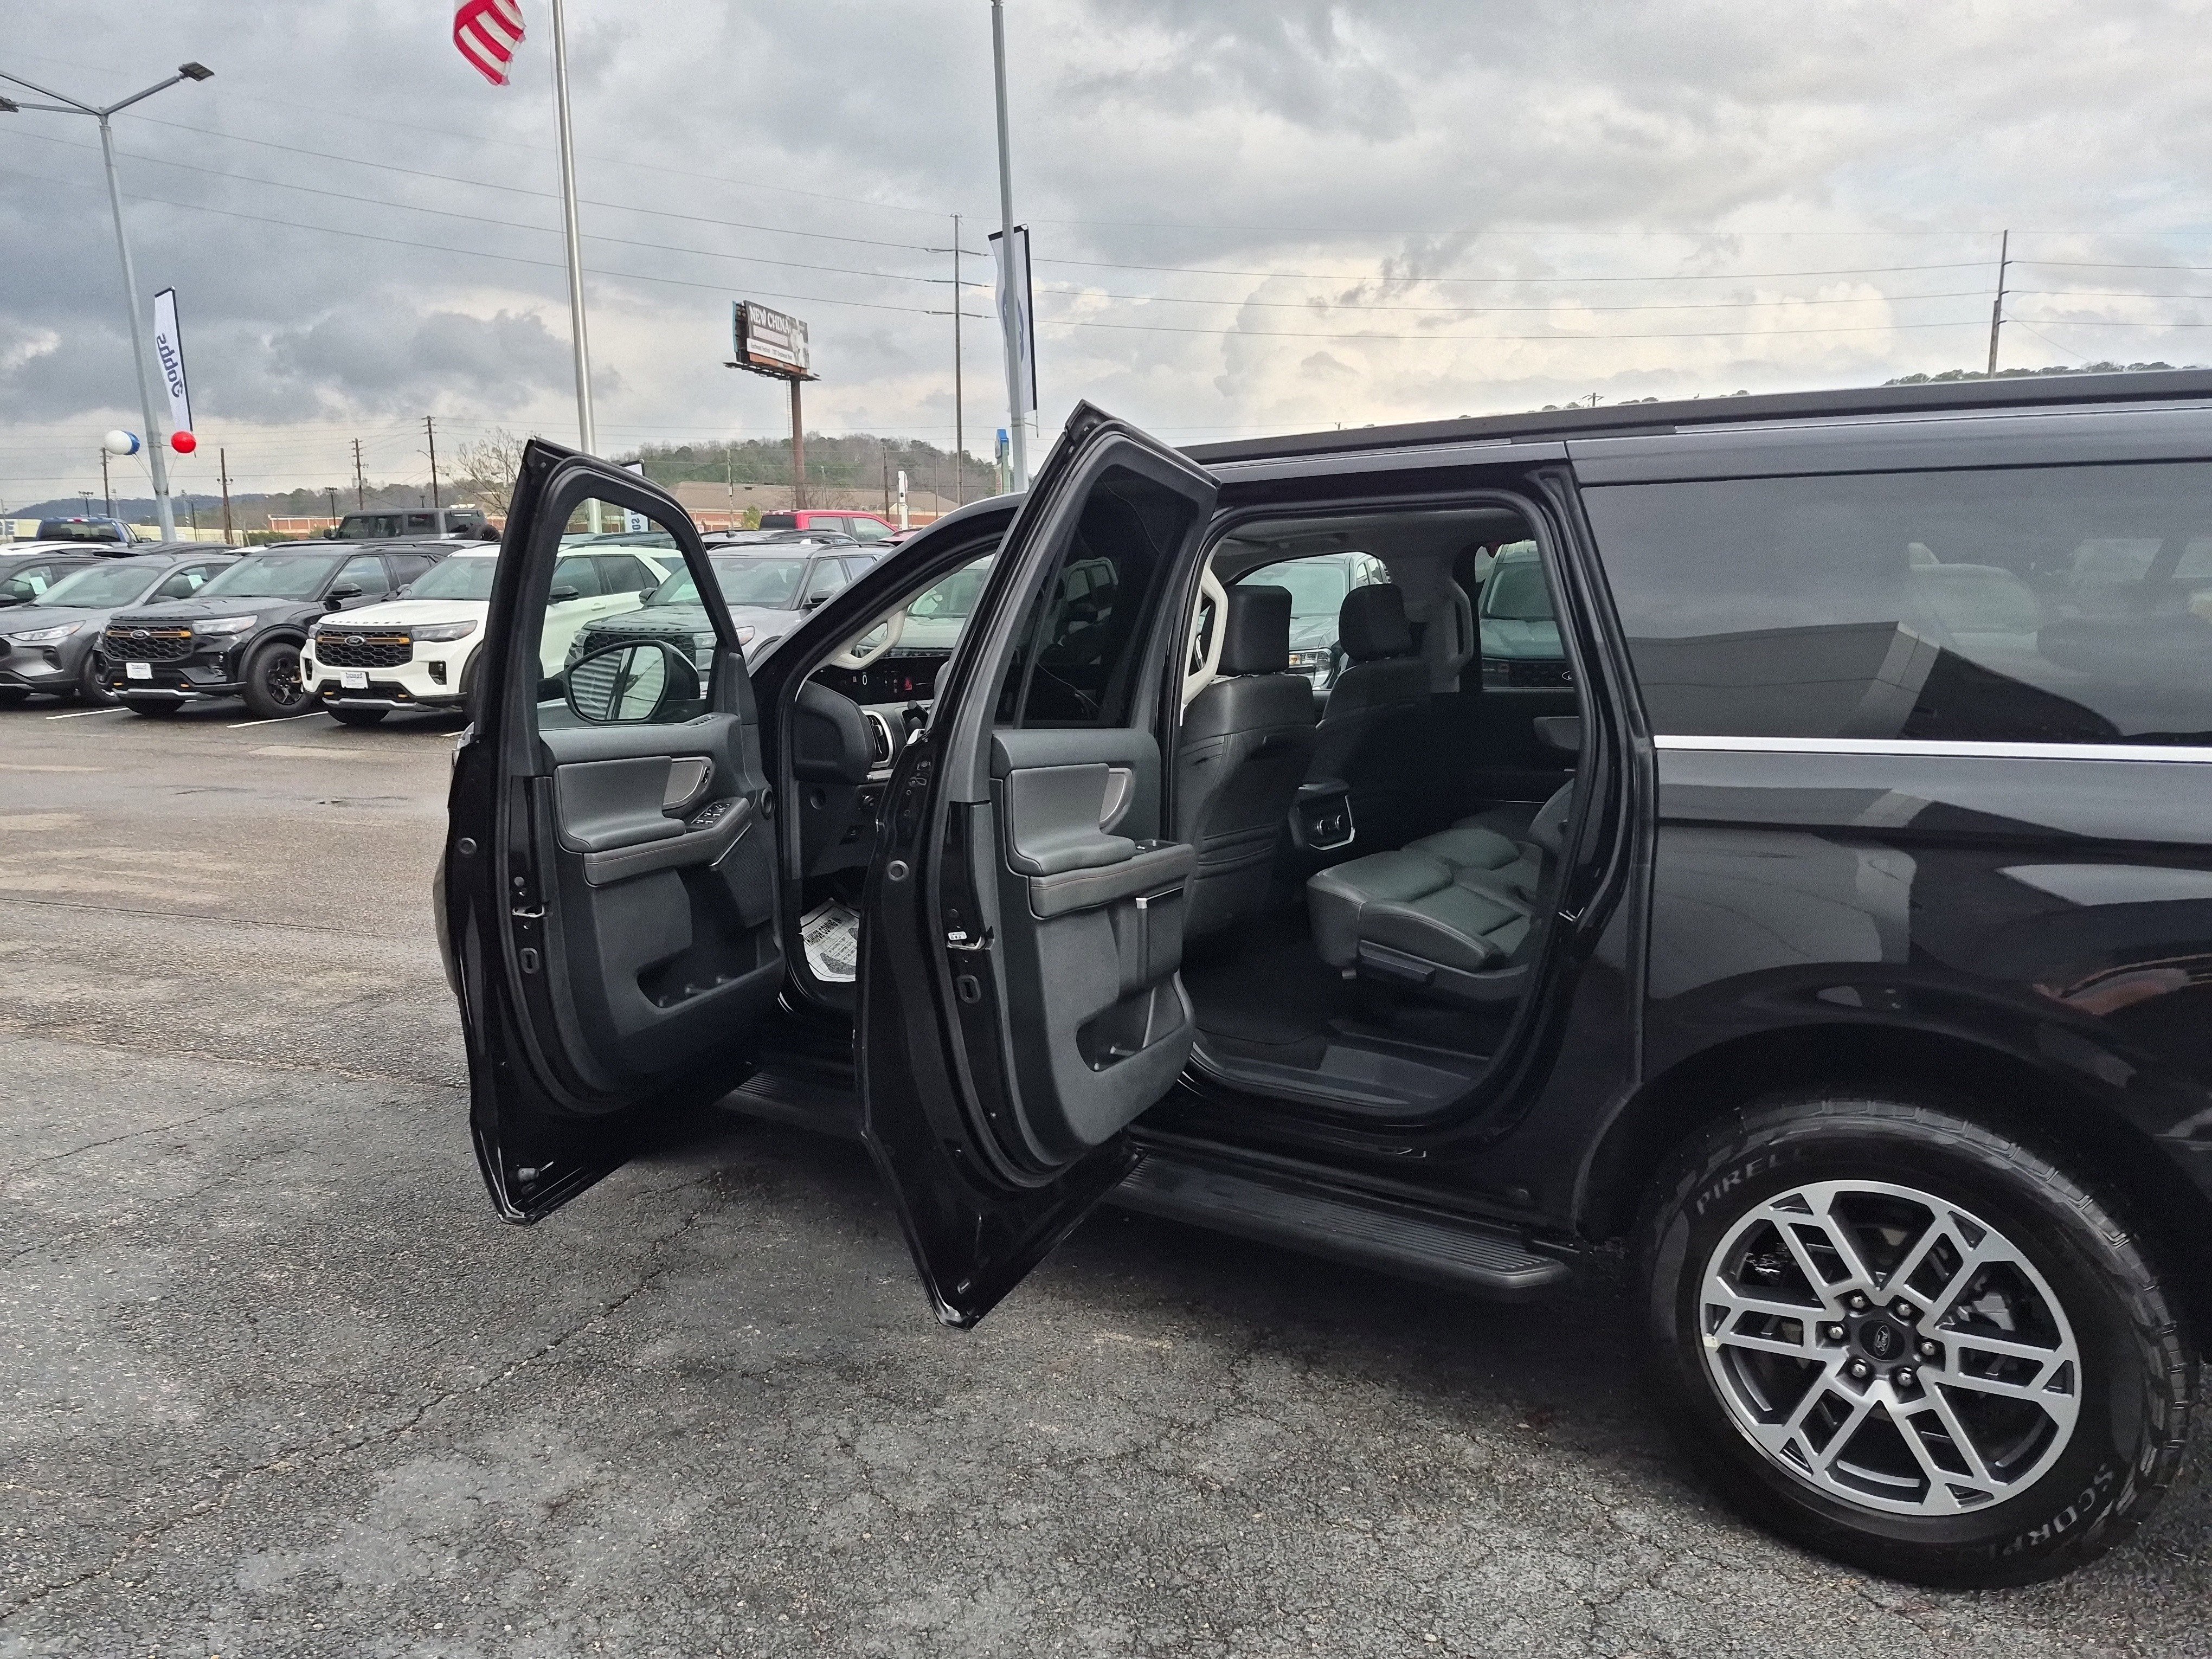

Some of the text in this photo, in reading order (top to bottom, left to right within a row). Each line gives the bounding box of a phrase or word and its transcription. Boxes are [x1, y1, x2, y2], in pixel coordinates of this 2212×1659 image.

[749, 305, 790, 333] NEW CHINA
[1696, 1148, 1810, 1216] PIRELL
